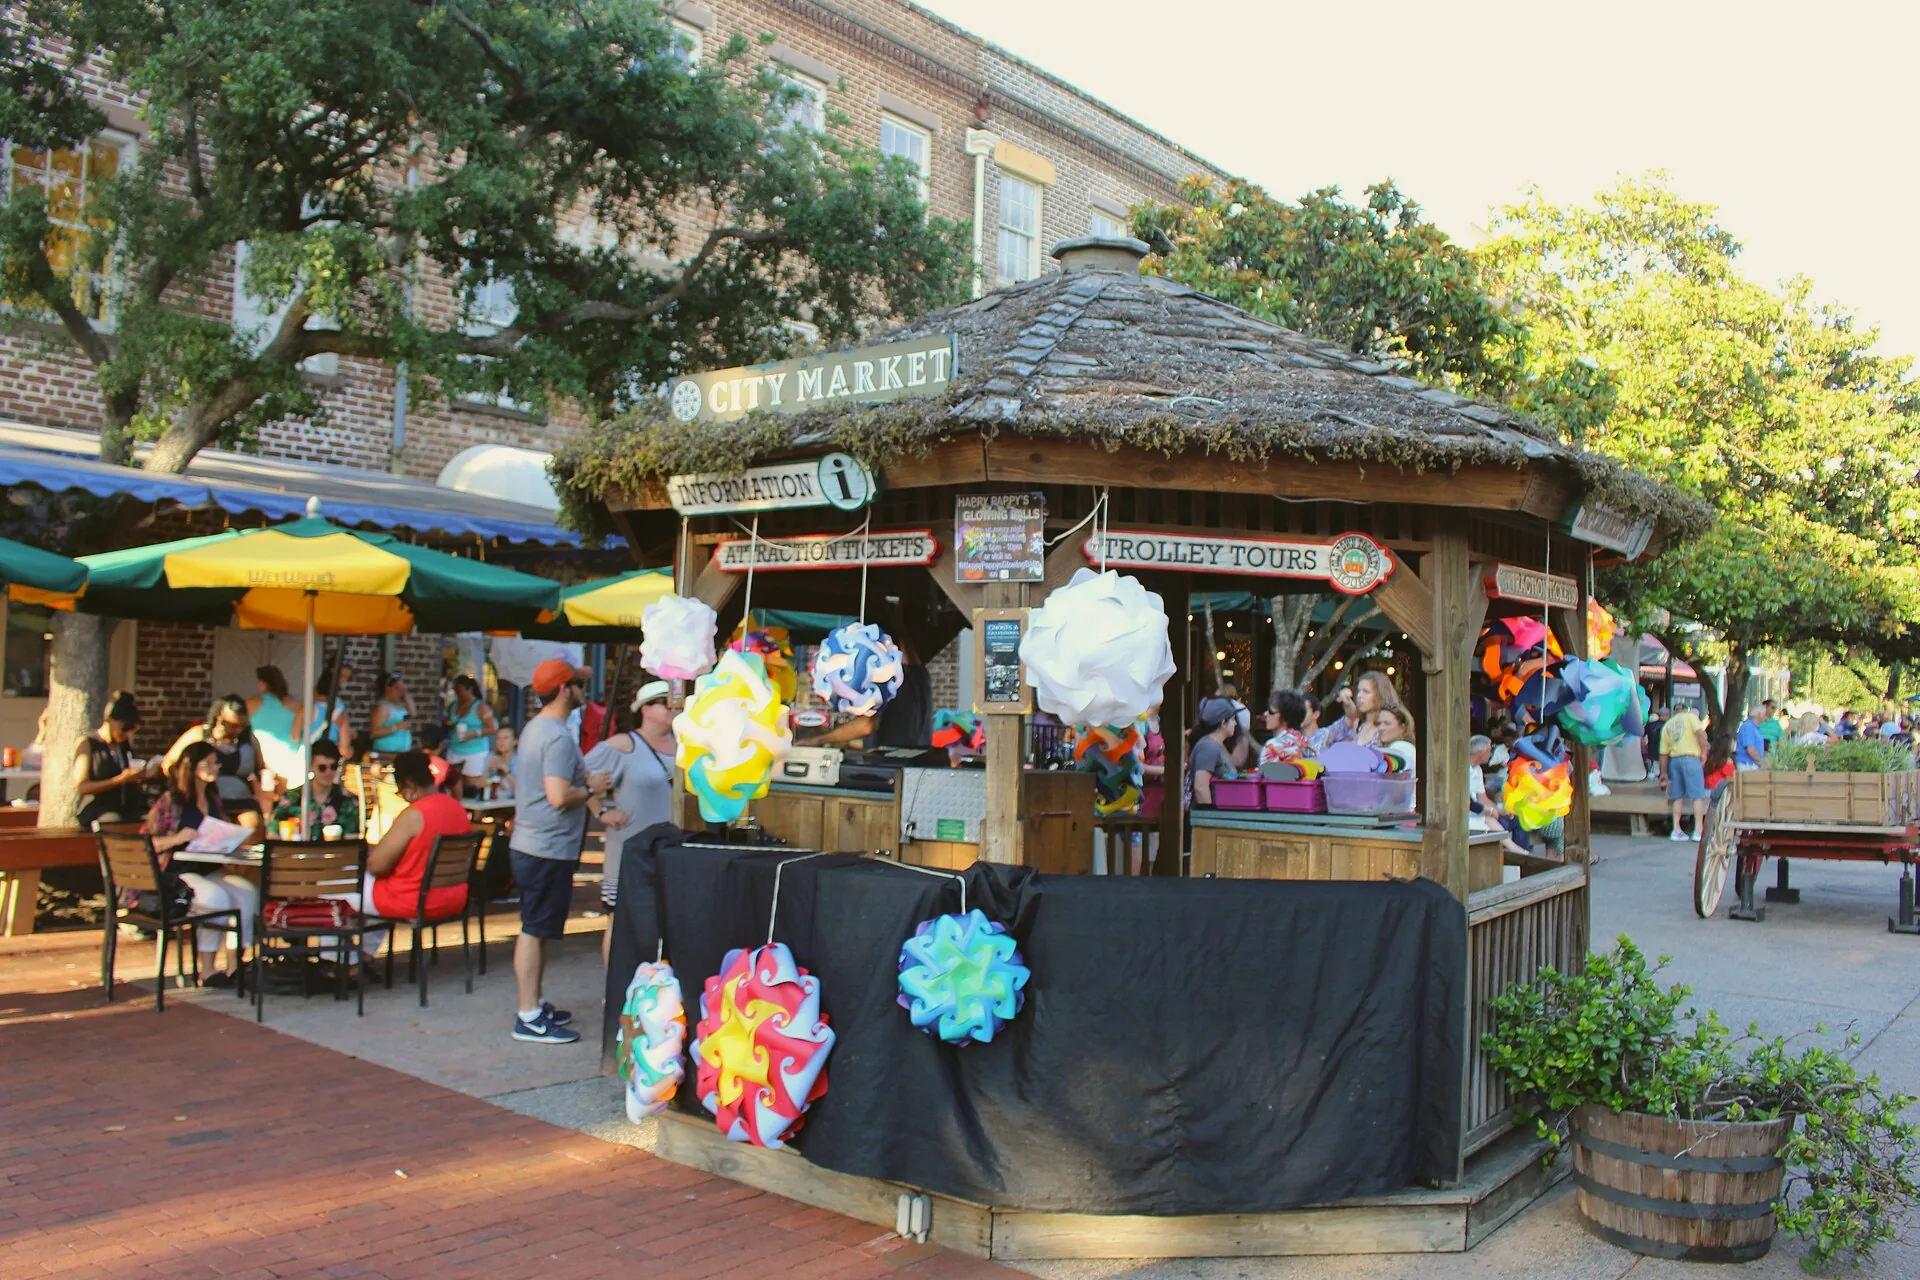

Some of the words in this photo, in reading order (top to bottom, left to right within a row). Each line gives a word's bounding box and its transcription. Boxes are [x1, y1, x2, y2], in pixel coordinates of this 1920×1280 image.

[708, 372, 787, 413] CITY
[796, 347, 951, 402] MARKET
[678, 473, 814, 506] INFORMATION
[831, 459, 859, 500] i
[963, 509, 1008, 521] GLOWING
[842, 537, 925, 561] TICKETS
[1105, 538, 1223, 565] TROLLEY
[1230, 547, 1318, 570] TOURS
[1337, 572, 1373, 588] TOURS
